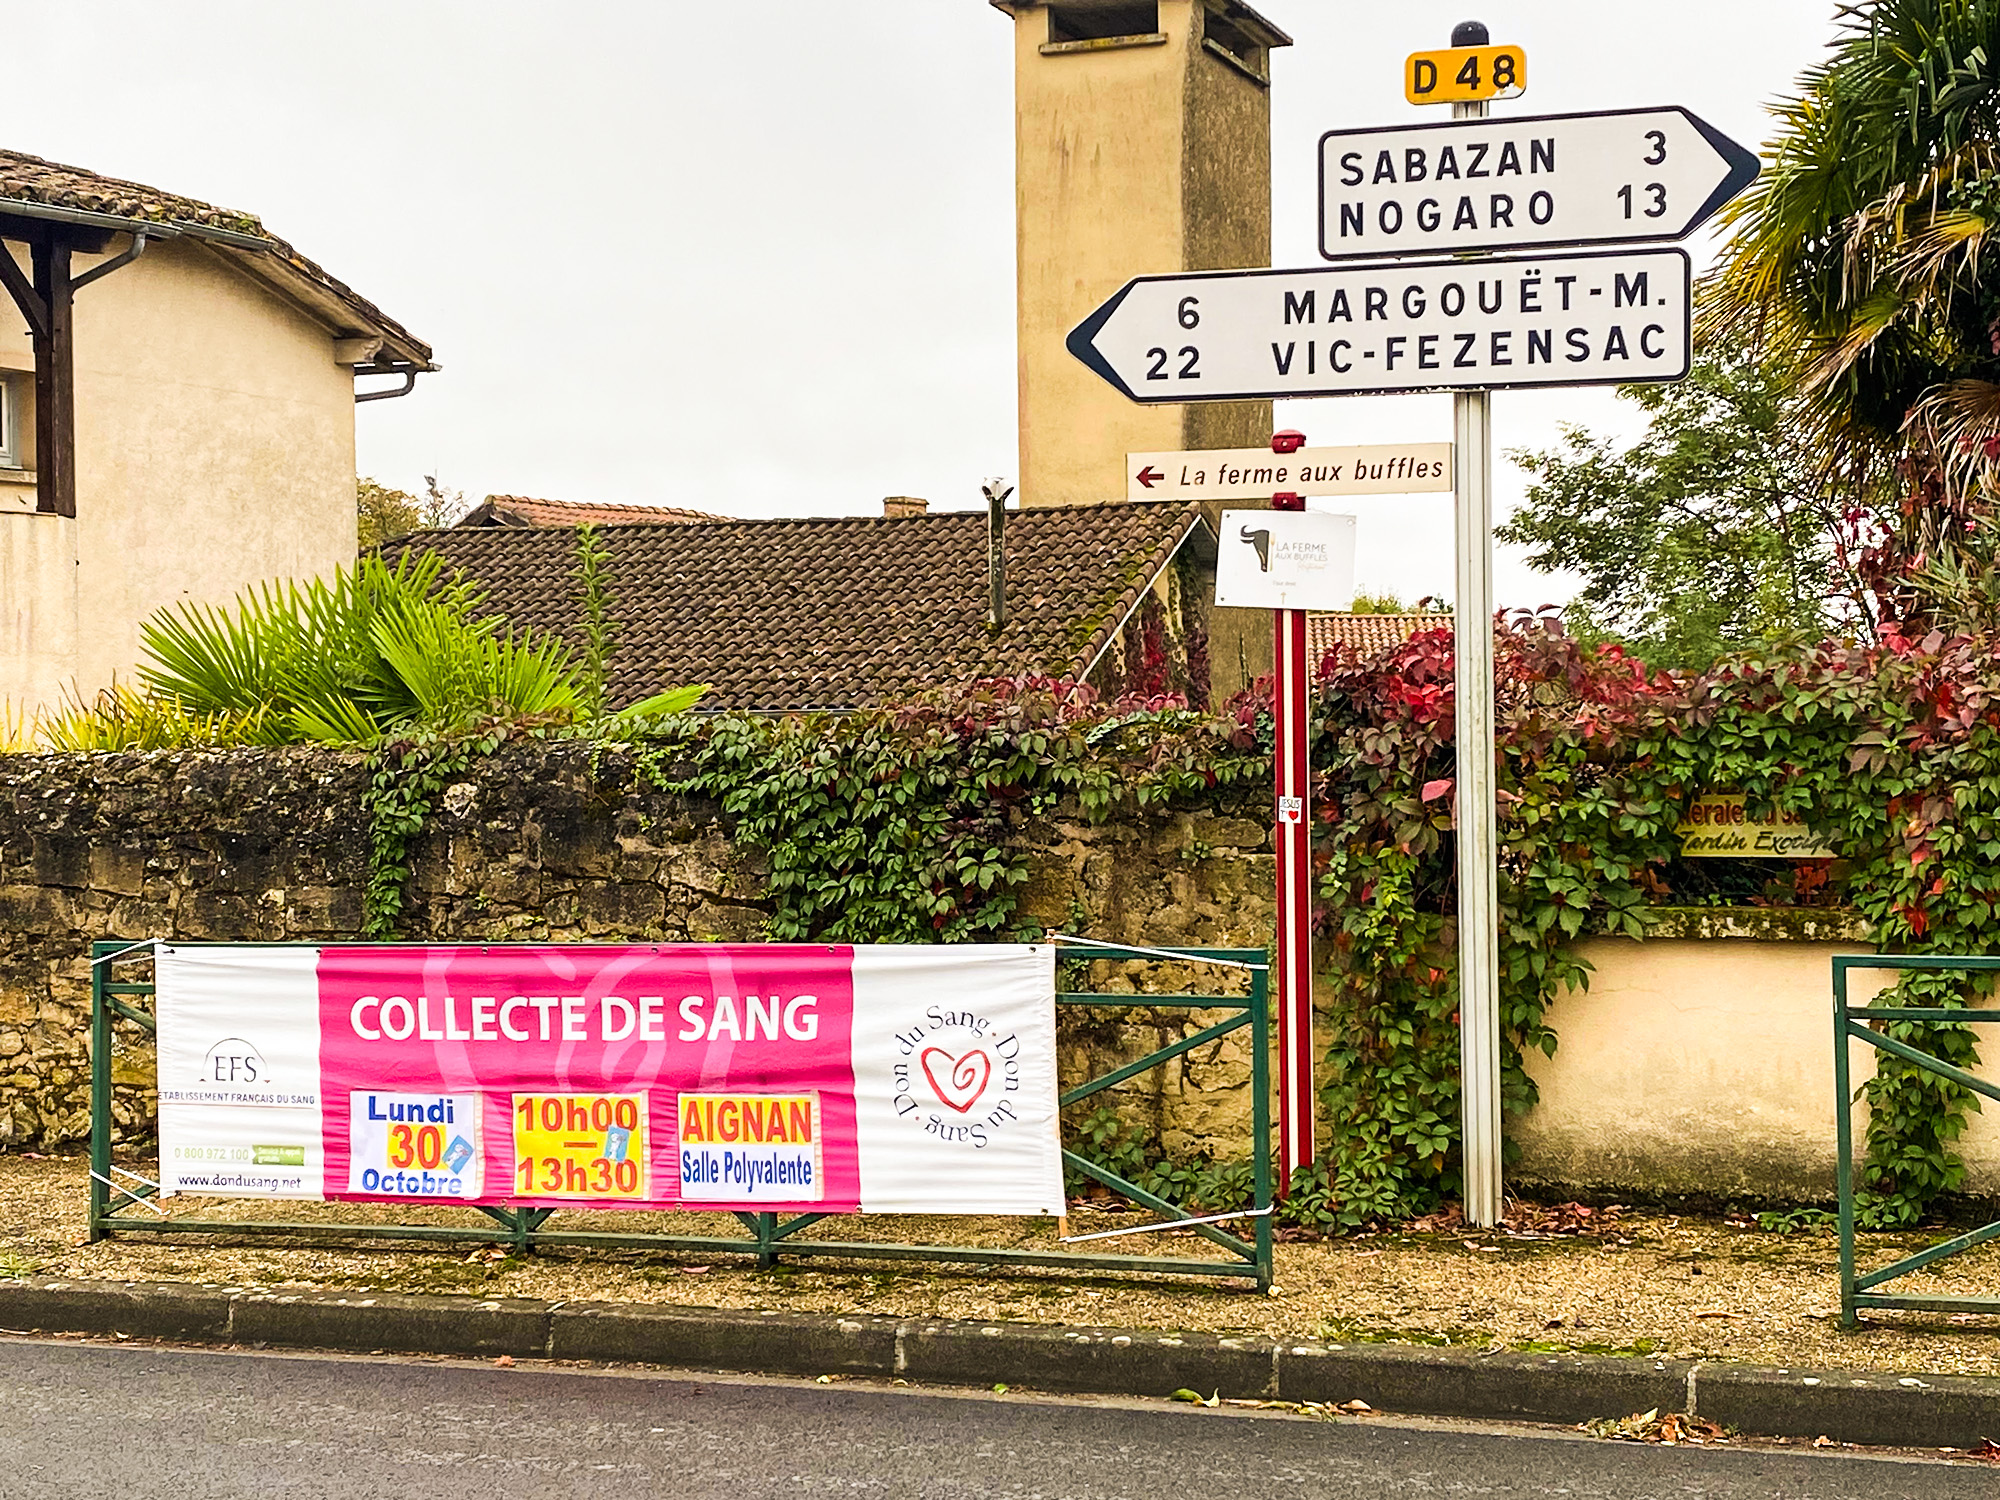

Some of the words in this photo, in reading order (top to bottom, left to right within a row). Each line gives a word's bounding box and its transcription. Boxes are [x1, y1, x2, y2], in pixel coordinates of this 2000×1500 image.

[1413, 60, 1438, 94] D
[1455, 54, 1516, 91] 48
[1340, 137, 1556, 187] SABAZAN
[1644, 130, 1667, 166] 3
[1340, 190, 1555, 238] NOGARO
[1616, 182, 1667, 220] 13
[1177, 296, 1200, 330] 6
[1284, 269, 1667, 325] MARGOUËT-M.
[1146, 345, 1201, 381] 22
[1271, 323, 1667, 377] VIC-FEZENSAC
[1180, 465, 1205, 487] La
[1218, 463, 1289, 486] ferme
[1300, 465, 1343, 482] aux
[1354, 457, 1444, 481] buffles
[1275, 552, 1292, 560] AUX
[1294, 552, 1328, 562] BUFFLES
[1276, 542, 1290, 552] LA
[1292, 542, 1327, 553] FERME
[1680, 830, 1748, 851] Jardin
[1754, 830, 1837, 855] Exotiqu
[350, 996, 588, 1042] COLLECTE
[602, 996, 664, 1042] DE
[678, 996, 819, 1042] SANG
[926, 1005, 991, 1039] Sang
[895, 1026, 925, 1056] du
[215, 1056, 257, 1083] EFS
[995, 1033, 1020, 1092] Don
[231, 1093, 275, 1105] FRANÇAIS
[276, 1094, 289, 1104] DU
[291, 1095, 315, 1105] SANG
[893, 1063, 919, 1117] Don
[368, 1095, 454, 1124] Lundi
[518, 1098, 638, 1132] 10h00
[682, 1100, 812, 1143] AIGNAN
[987, 1099, 1018, 1127] du
[391, 1124, 441, 1169] 30
[924, 1113, 988, 1148] Sang
[174, 1147, 181, 1158] 0
[184, 1147, 204, 1159] 800
[206, 1148, 226, 1160] 972
[230, 1149, 249, 1161] 100
[178, 1173, 302, 1192] www.dondusang.net
[362, 1168, 462, 1194] Octobre
[518, 1157, 638, 1193] 13h30
[682, 1150, 719, 1183] Salle
[724, 1151, 812, 1193] Polyvalente
